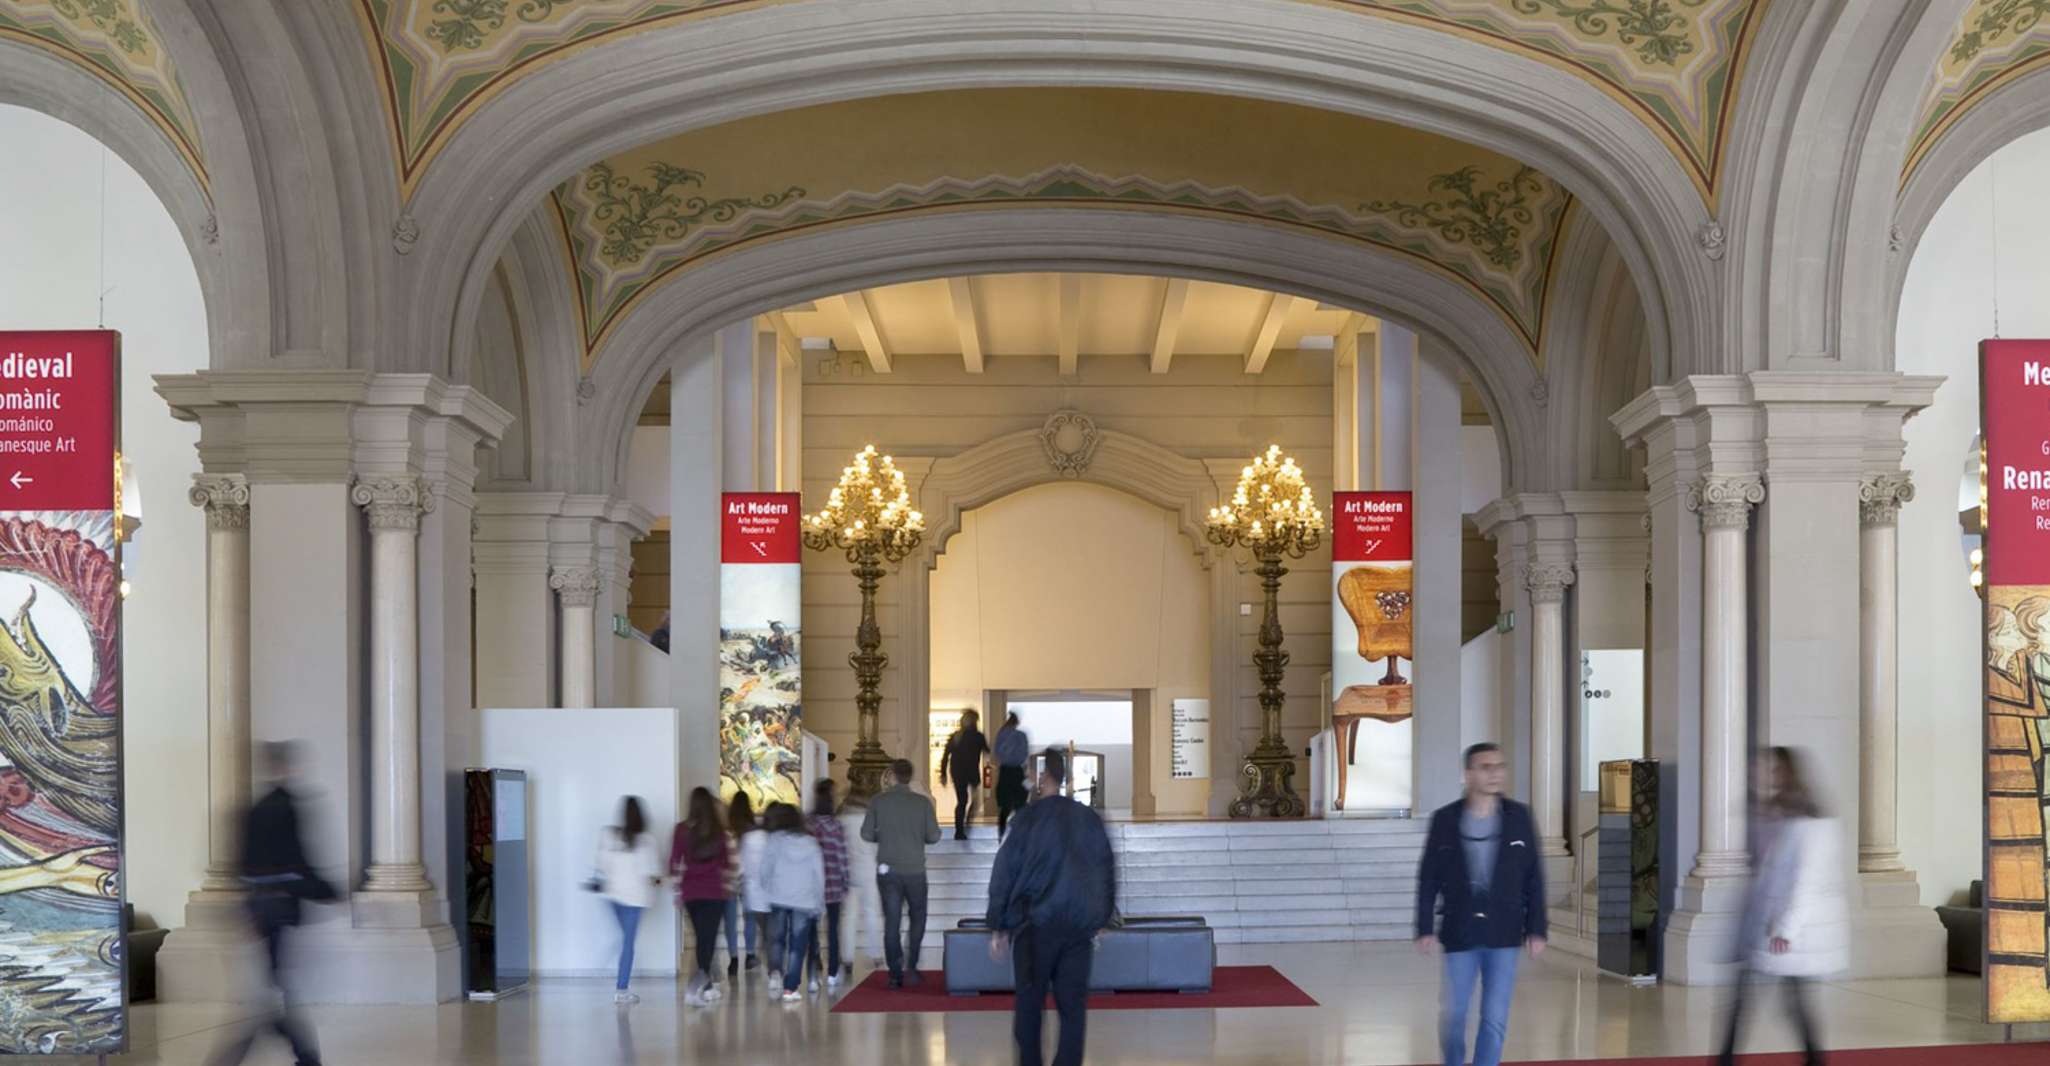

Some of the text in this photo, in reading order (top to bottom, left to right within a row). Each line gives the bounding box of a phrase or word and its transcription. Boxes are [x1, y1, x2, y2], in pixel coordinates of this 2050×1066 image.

[0, 351, 72, 378] dieval
[2023, 361, 2050, 386] Me
[55, 436, 76, 453] Art
[728, 501, 788, 514] Art Modern
[1344, 500, 1403, 513] Art Modern
[737, 516, 751, 524] Arte
[741, 526, 776, 534] Modern Art
[1356, 524, 1391, 532] Modern Art
